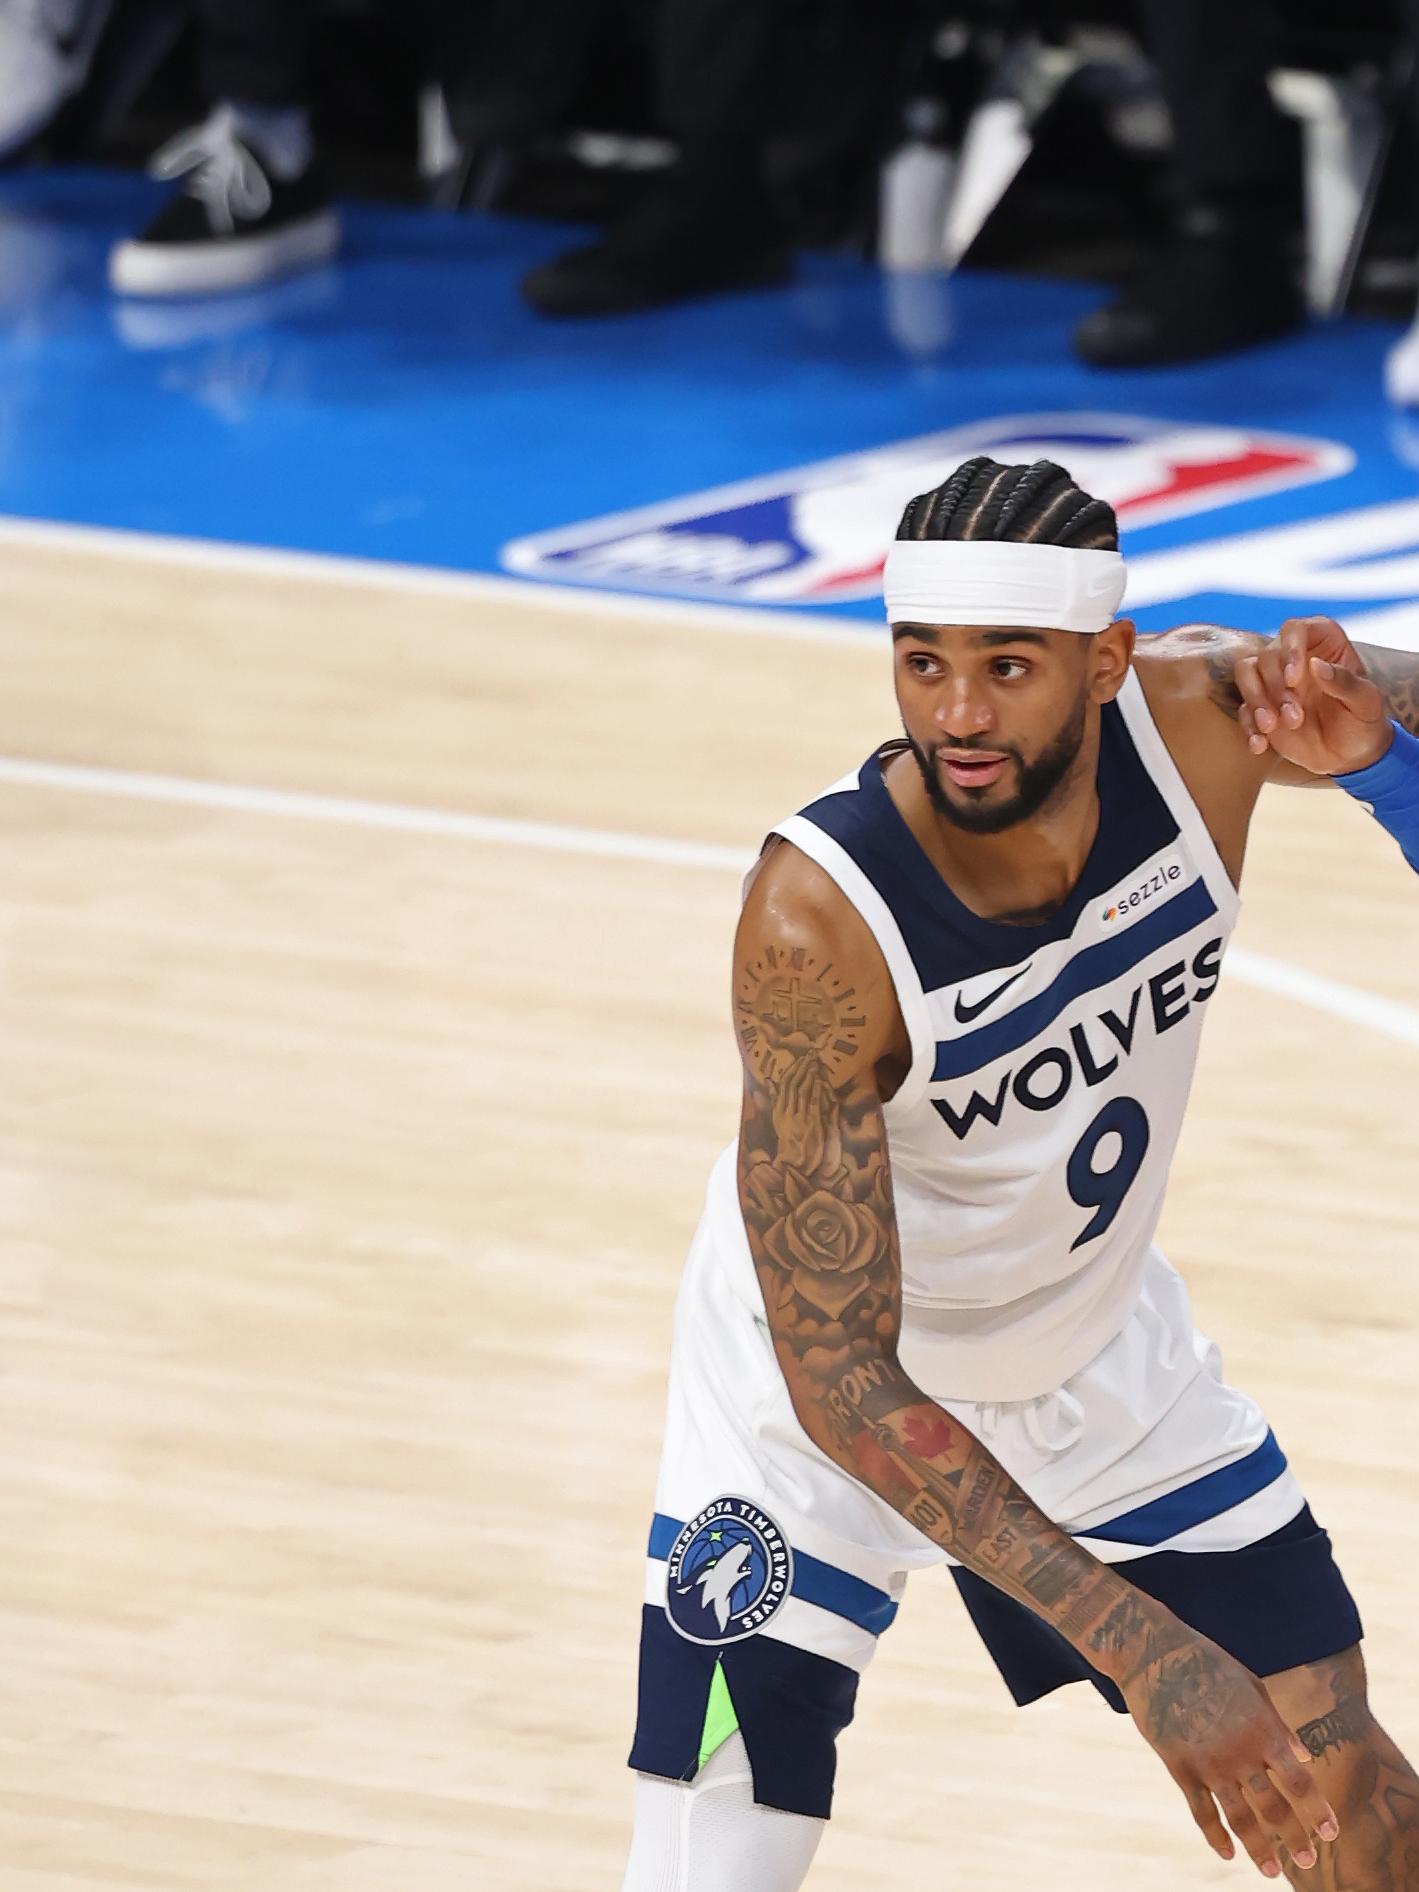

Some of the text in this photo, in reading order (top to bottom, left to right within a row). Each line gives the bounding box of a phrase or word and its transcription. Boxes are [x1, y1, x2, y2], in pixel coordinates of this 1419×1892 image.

[1118, 864, 1181, 915] sezzle
[931, 937, 1223, 1140] WOLVES
[1067, 1096, 1150, 1253] 9
[669, 1501, 788, 1630] MINNESOTA TIMBERWOLVES
